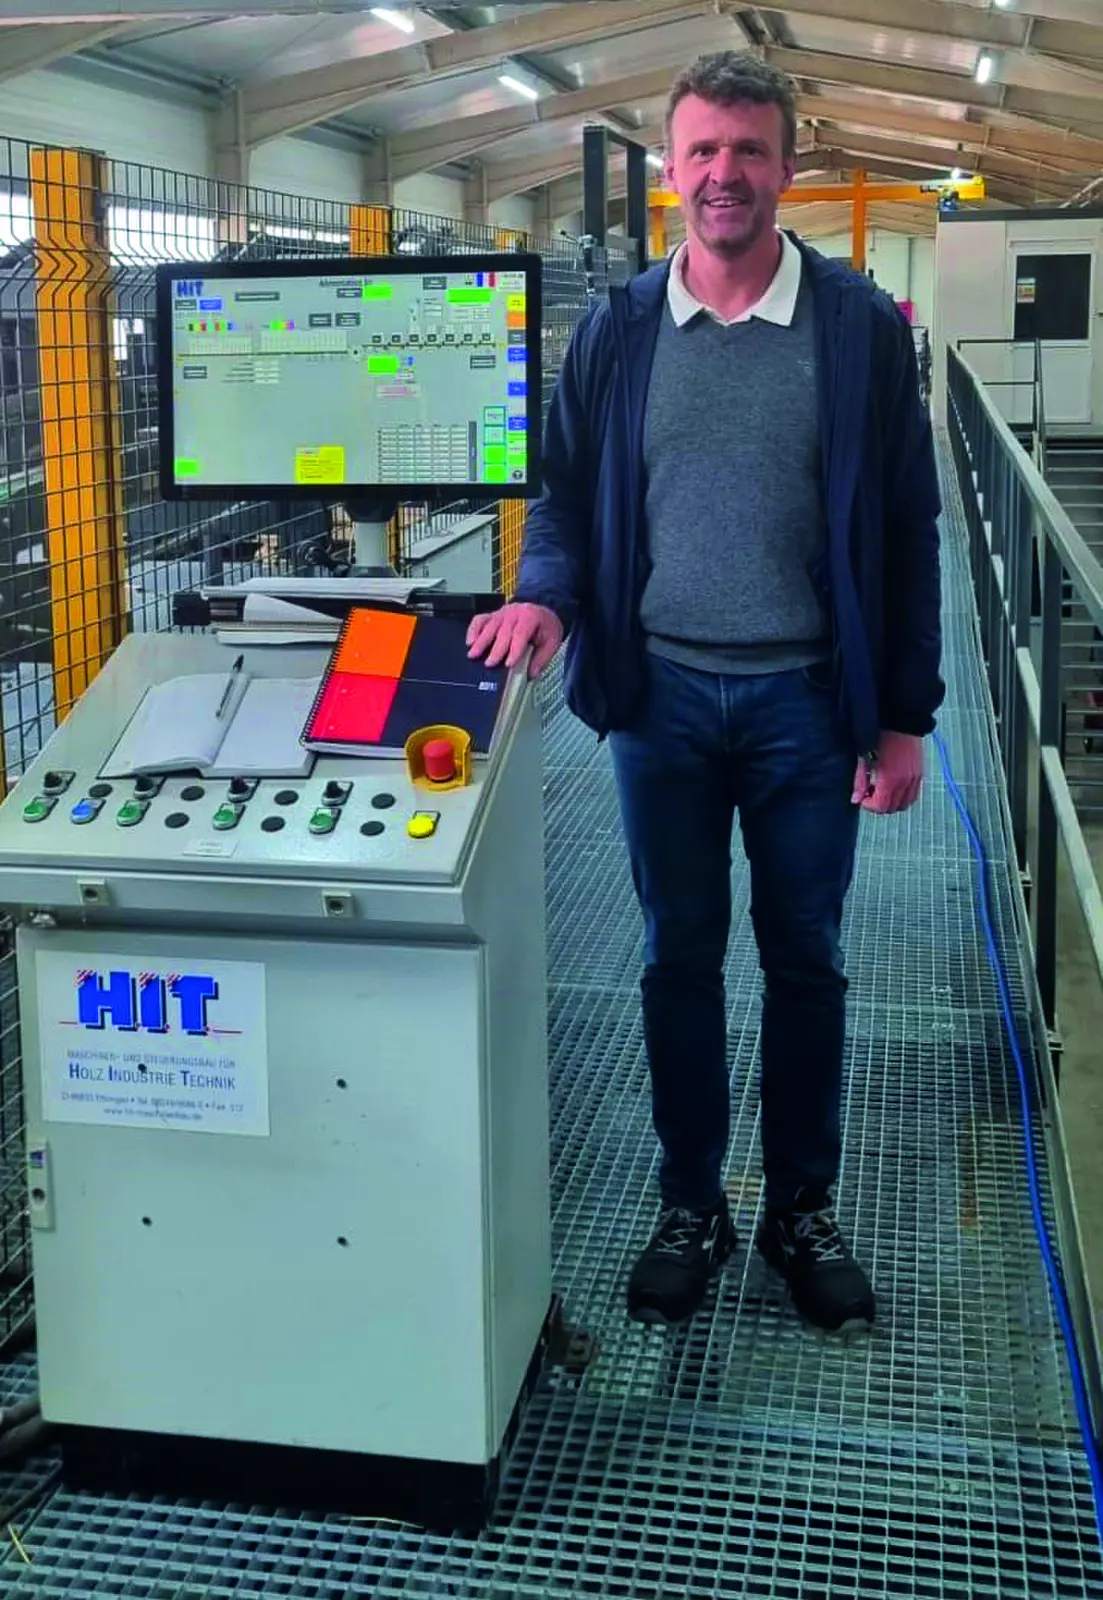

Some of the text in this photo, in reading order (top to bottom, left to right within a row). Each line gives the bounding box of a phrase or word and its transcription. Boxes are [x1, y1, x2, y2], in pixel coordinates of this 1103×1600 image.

[177, 280, 203, 297] HIT
[74, 970, 219, 1035] HIT
[69, 1062, 235, 1090] HOLZ INDUSTRIE TECHNIK
